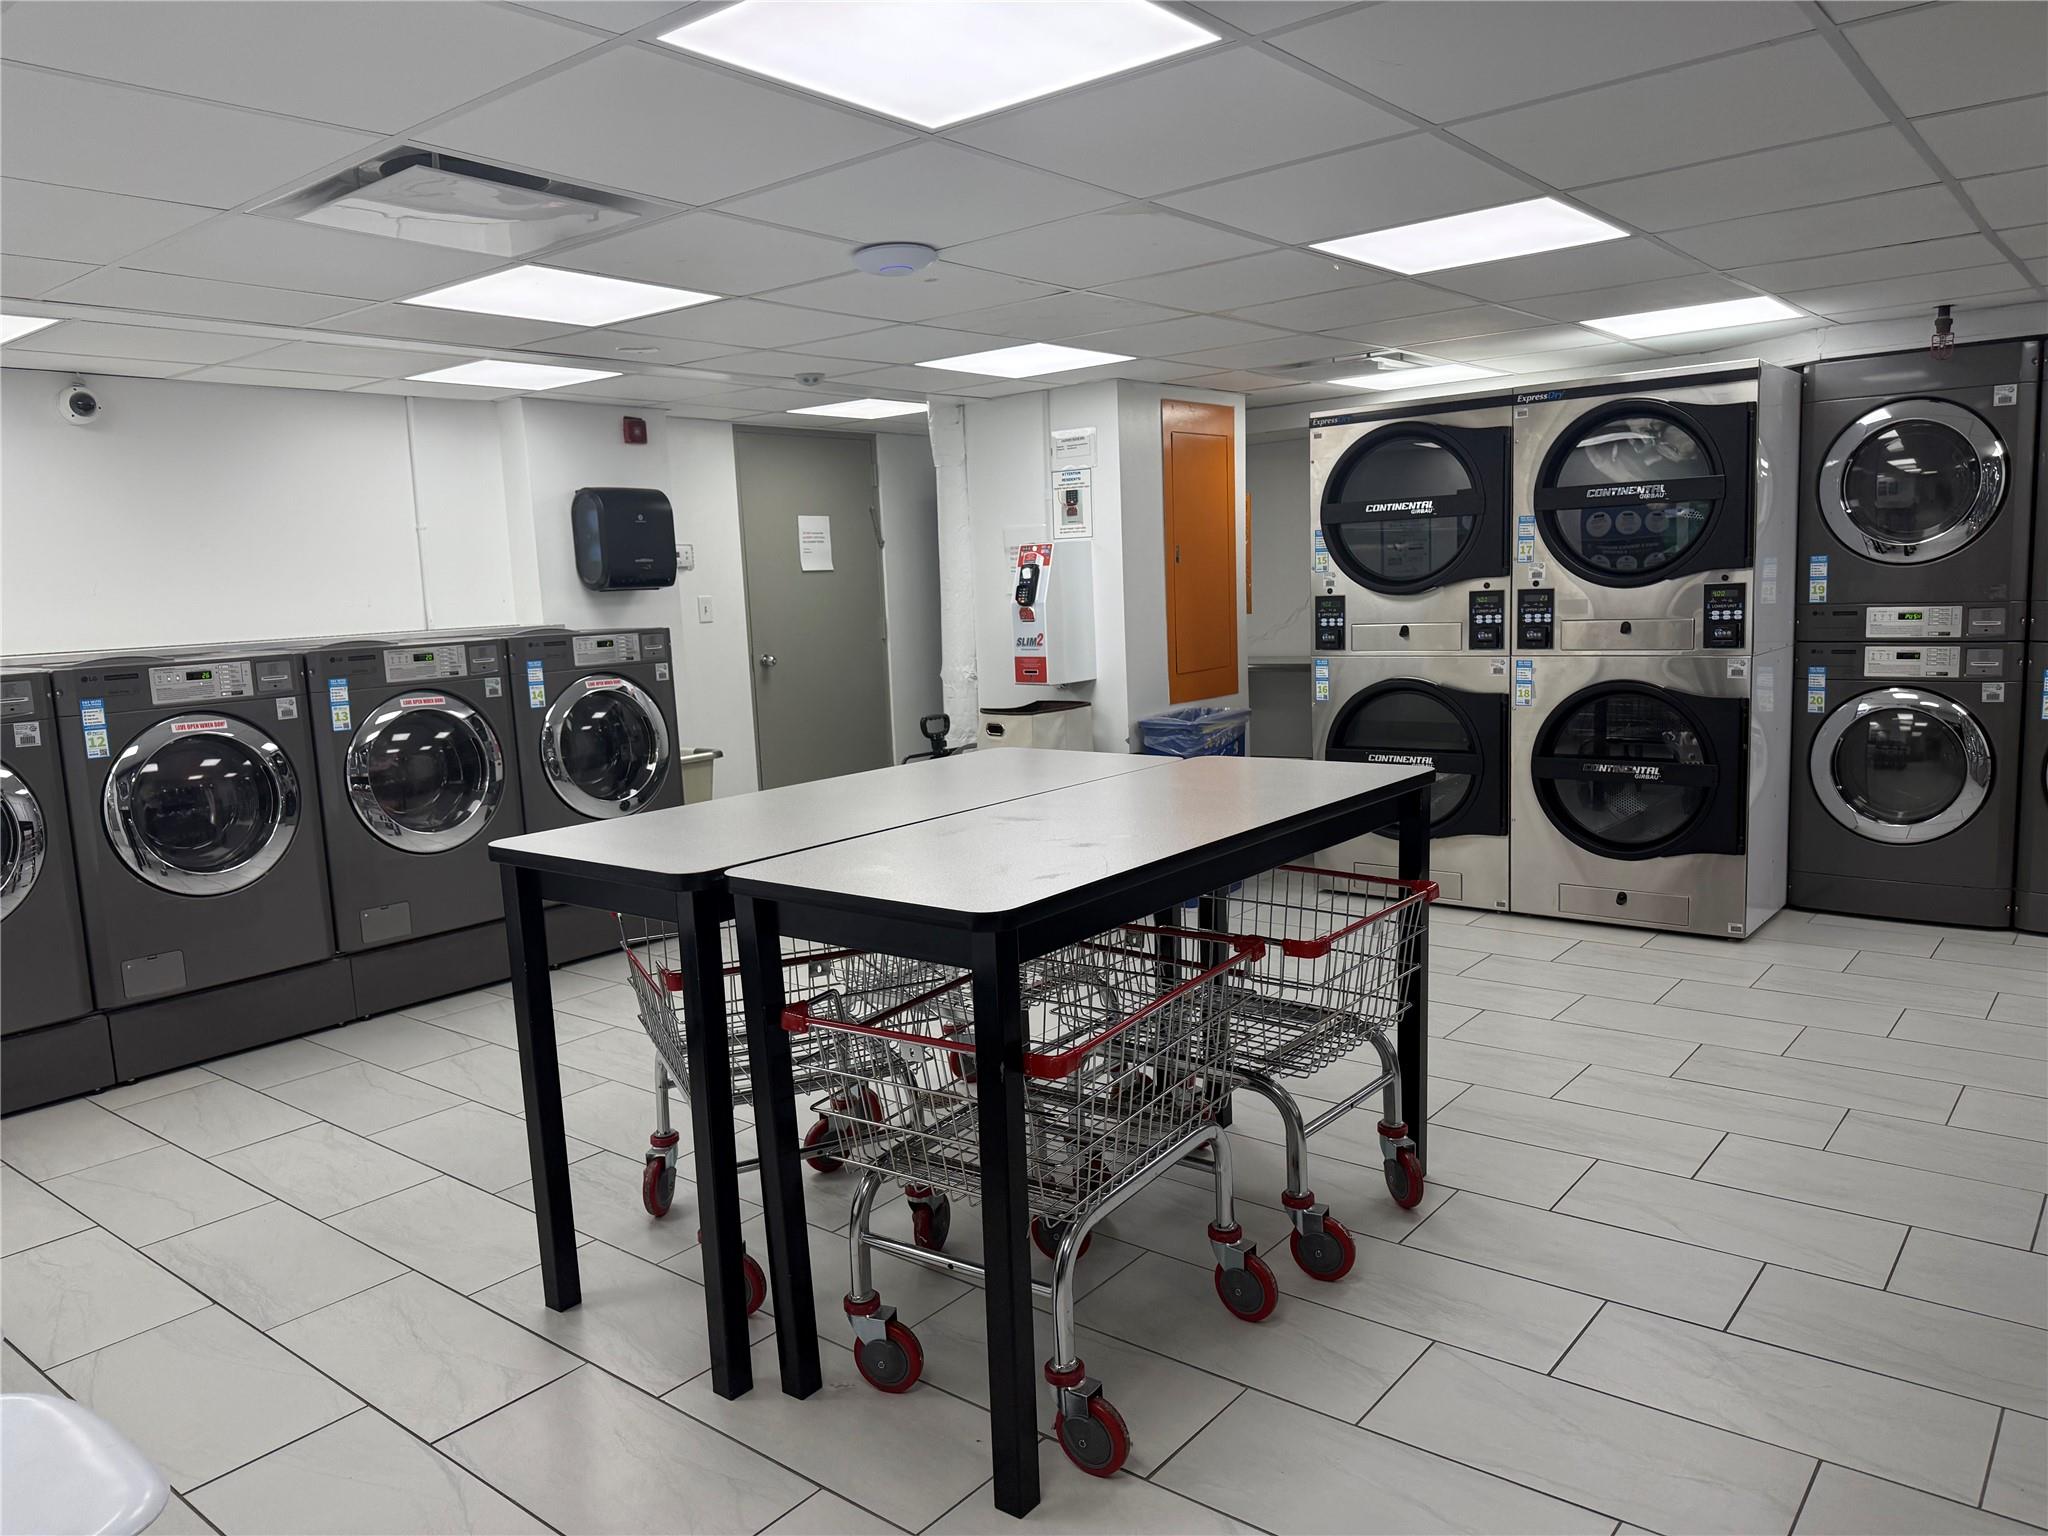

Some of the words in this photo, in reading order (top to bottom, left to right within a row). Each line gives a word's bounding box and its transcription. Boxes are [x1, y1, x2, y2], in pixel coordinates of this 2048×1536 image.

[1586, 484, 1666, 498] CONTINENTAL
[1365, 500, 1433, 513] CONTINENTAL
[1519, 545, 1532, 555] 17
[1317, 556, 1327, 565] 15
[1811, 585, 1825, 595] 19
[532, 690, 544, 700] 14
[1317, 685, 1328, 694] 16
[1518, 689, 1530, 698] 18
[1809, 695, 1824, 706] 20
[334, 711, 349, 722] 13
[88, 736, 107, 748] 12
[1368, 754, 1434, 765] CONTINENTAL
[1582, 763, 1661, 775] CONTINENTAL
